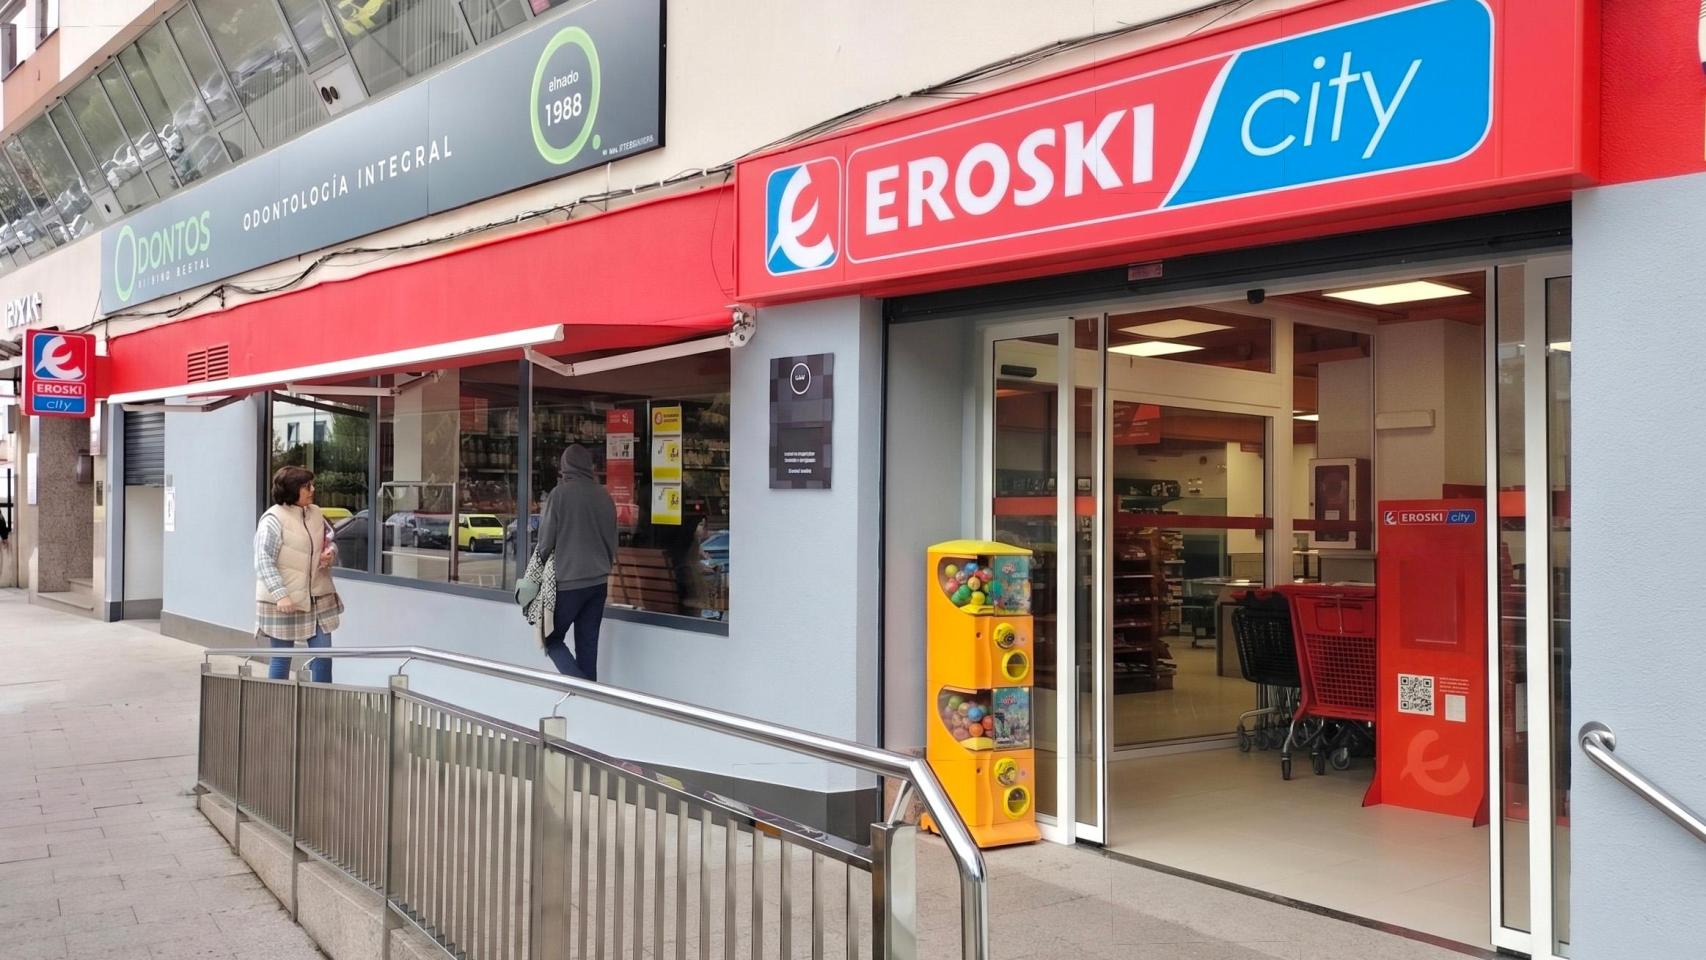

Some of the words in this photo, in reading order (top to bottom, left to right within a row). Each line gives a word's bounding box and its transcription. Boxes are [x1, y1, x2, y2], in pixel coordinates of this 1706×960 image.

[545, 92, 582, 127] 1988
[865, 104, 1155, 235] EROSKI
[1241, 52, 1423, 159] city
[243, 174, 349, 231] ODONTOLOGÍA
[357, 135, 453, 189] INTEGRAL
[36, 384, 82, 395] EROSKI
[1401, 512, 1443, 522] EROSKI
[1450, 511, 1470, 523] city
